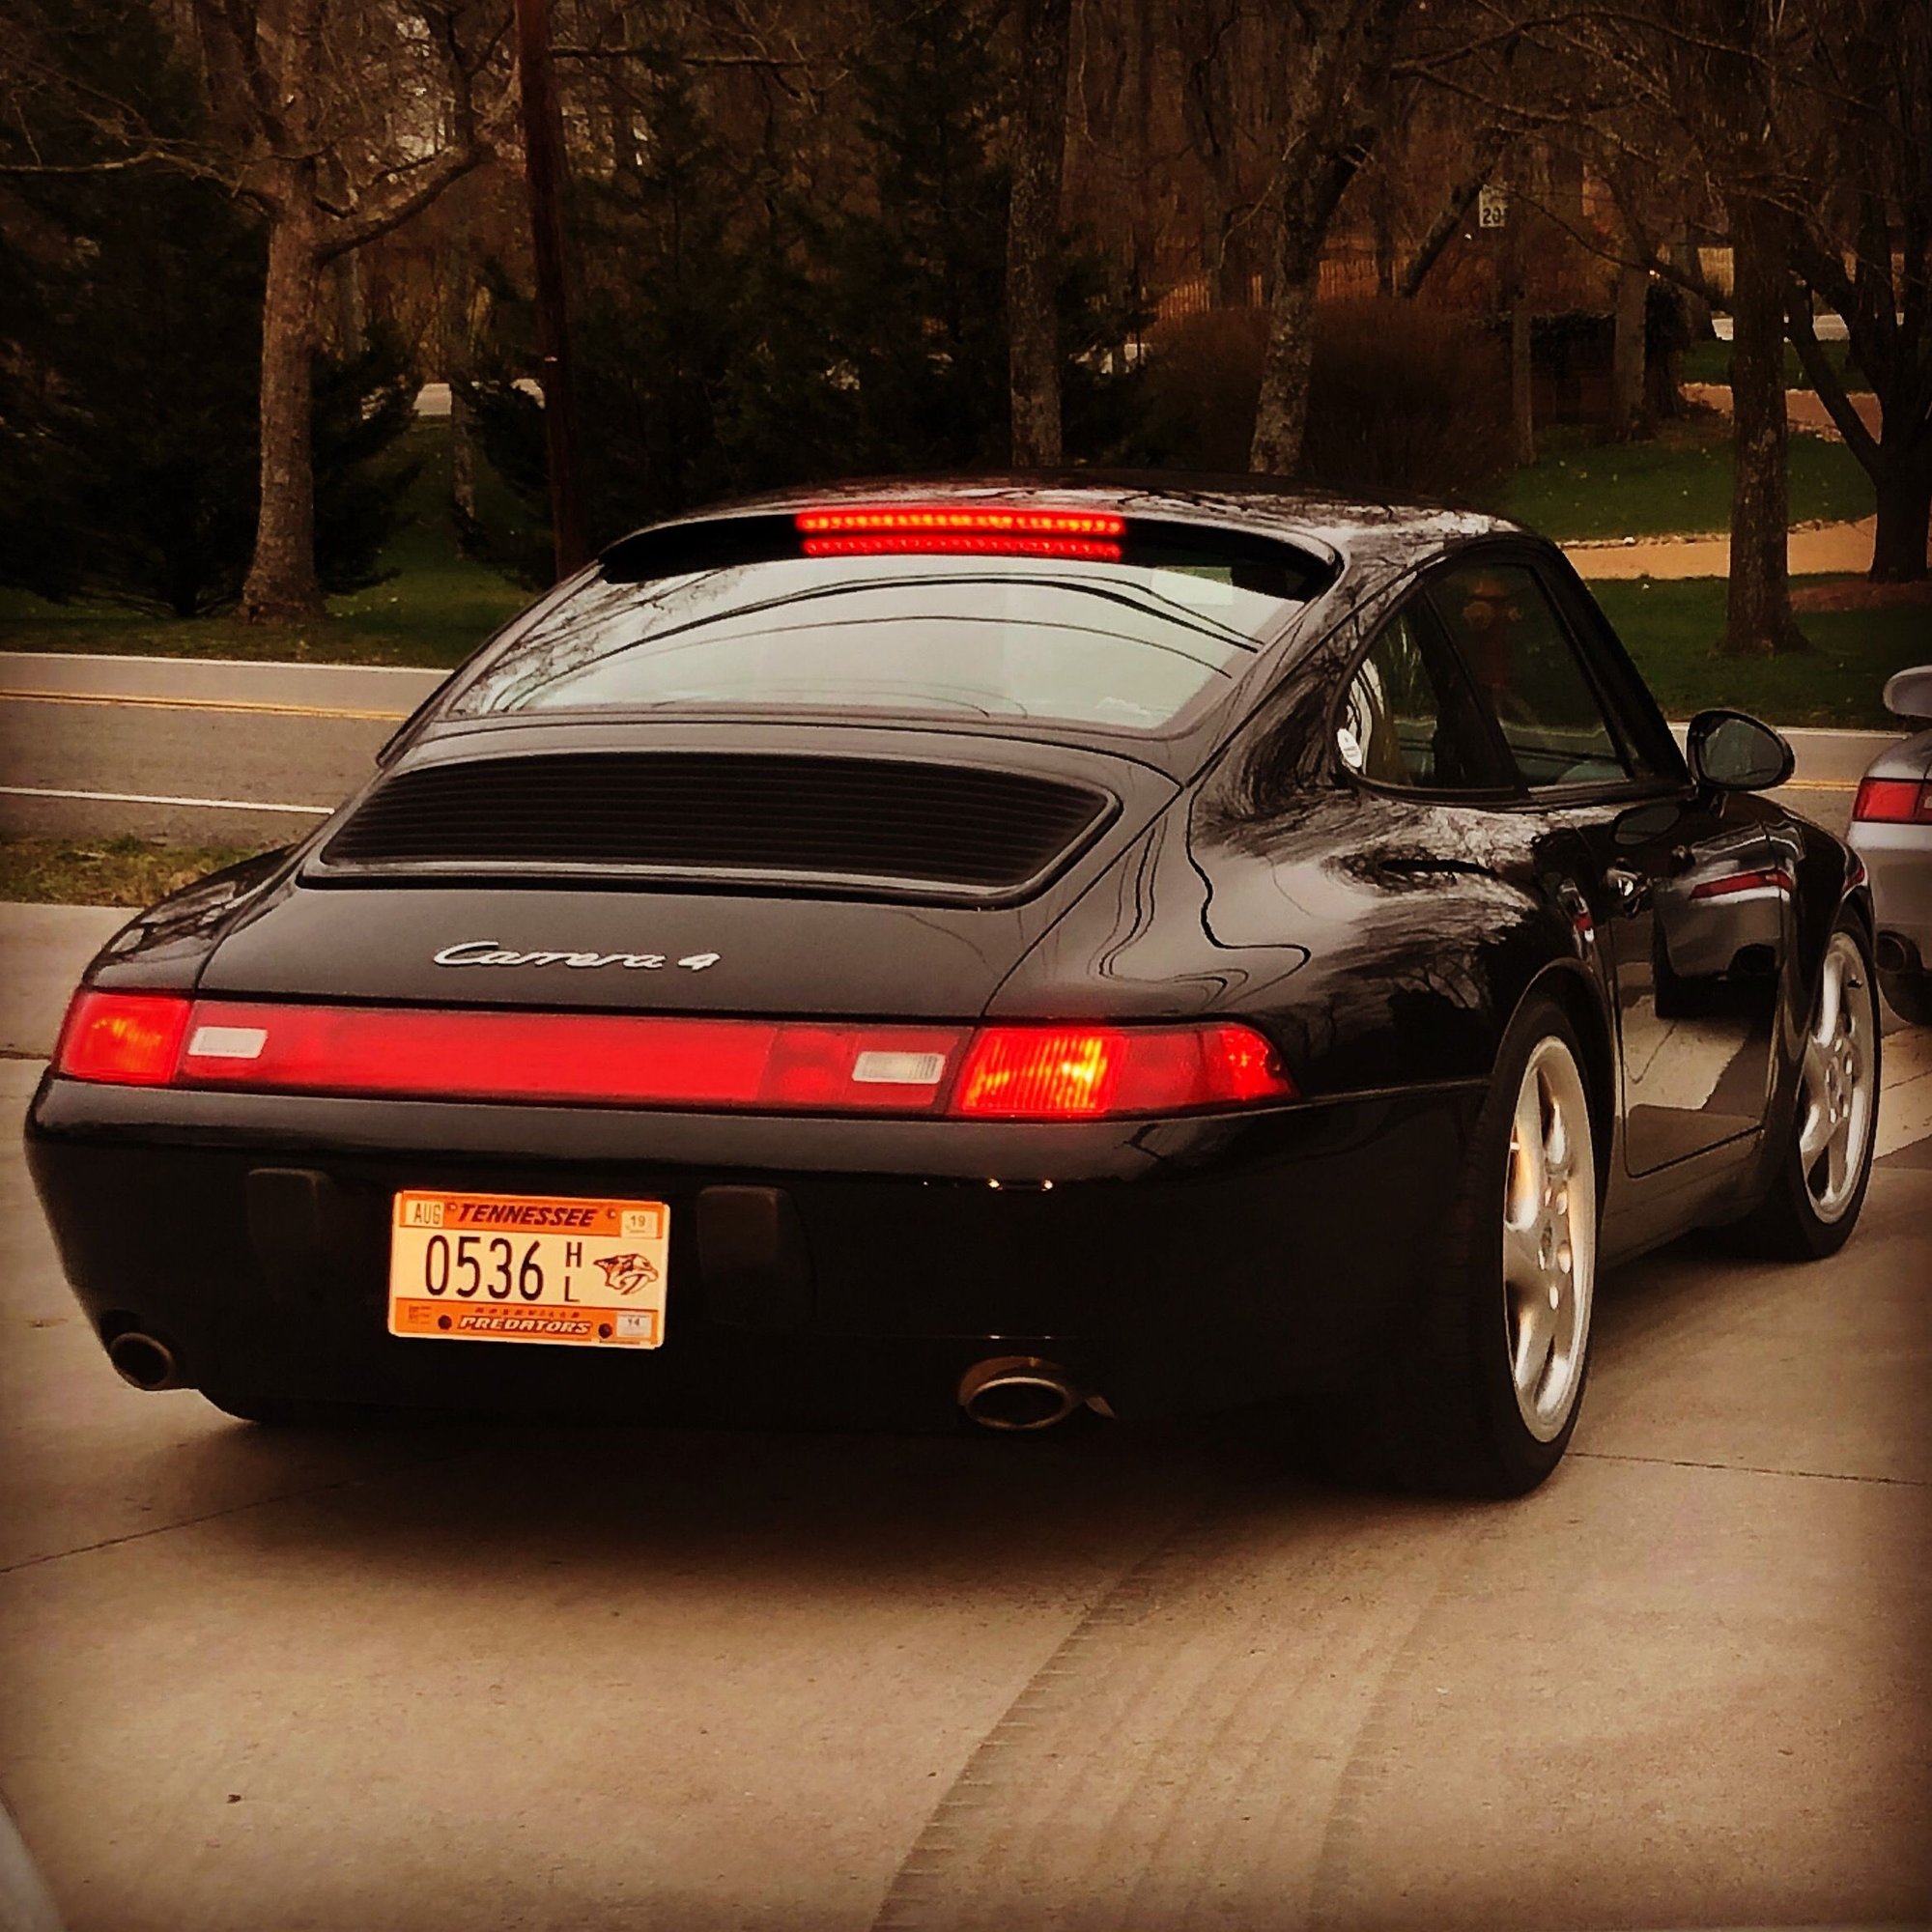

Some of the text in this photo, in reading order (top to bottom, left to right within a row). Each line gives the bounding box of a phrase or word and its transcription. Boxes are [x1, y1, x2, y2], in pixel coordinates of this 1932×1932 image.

[1483, 207, 1502, 225] 20
[434, 940, 722, 971] Carrera 4
[413, 1203, 442, 1224] AUG
[456, 1203, 598, 1227] TENNESSEE
[630, 1214, 646, 1228] 19
[425, 1235, 544, 1301] 0536
[457, 1315, 592, 1335] PREDATORS
